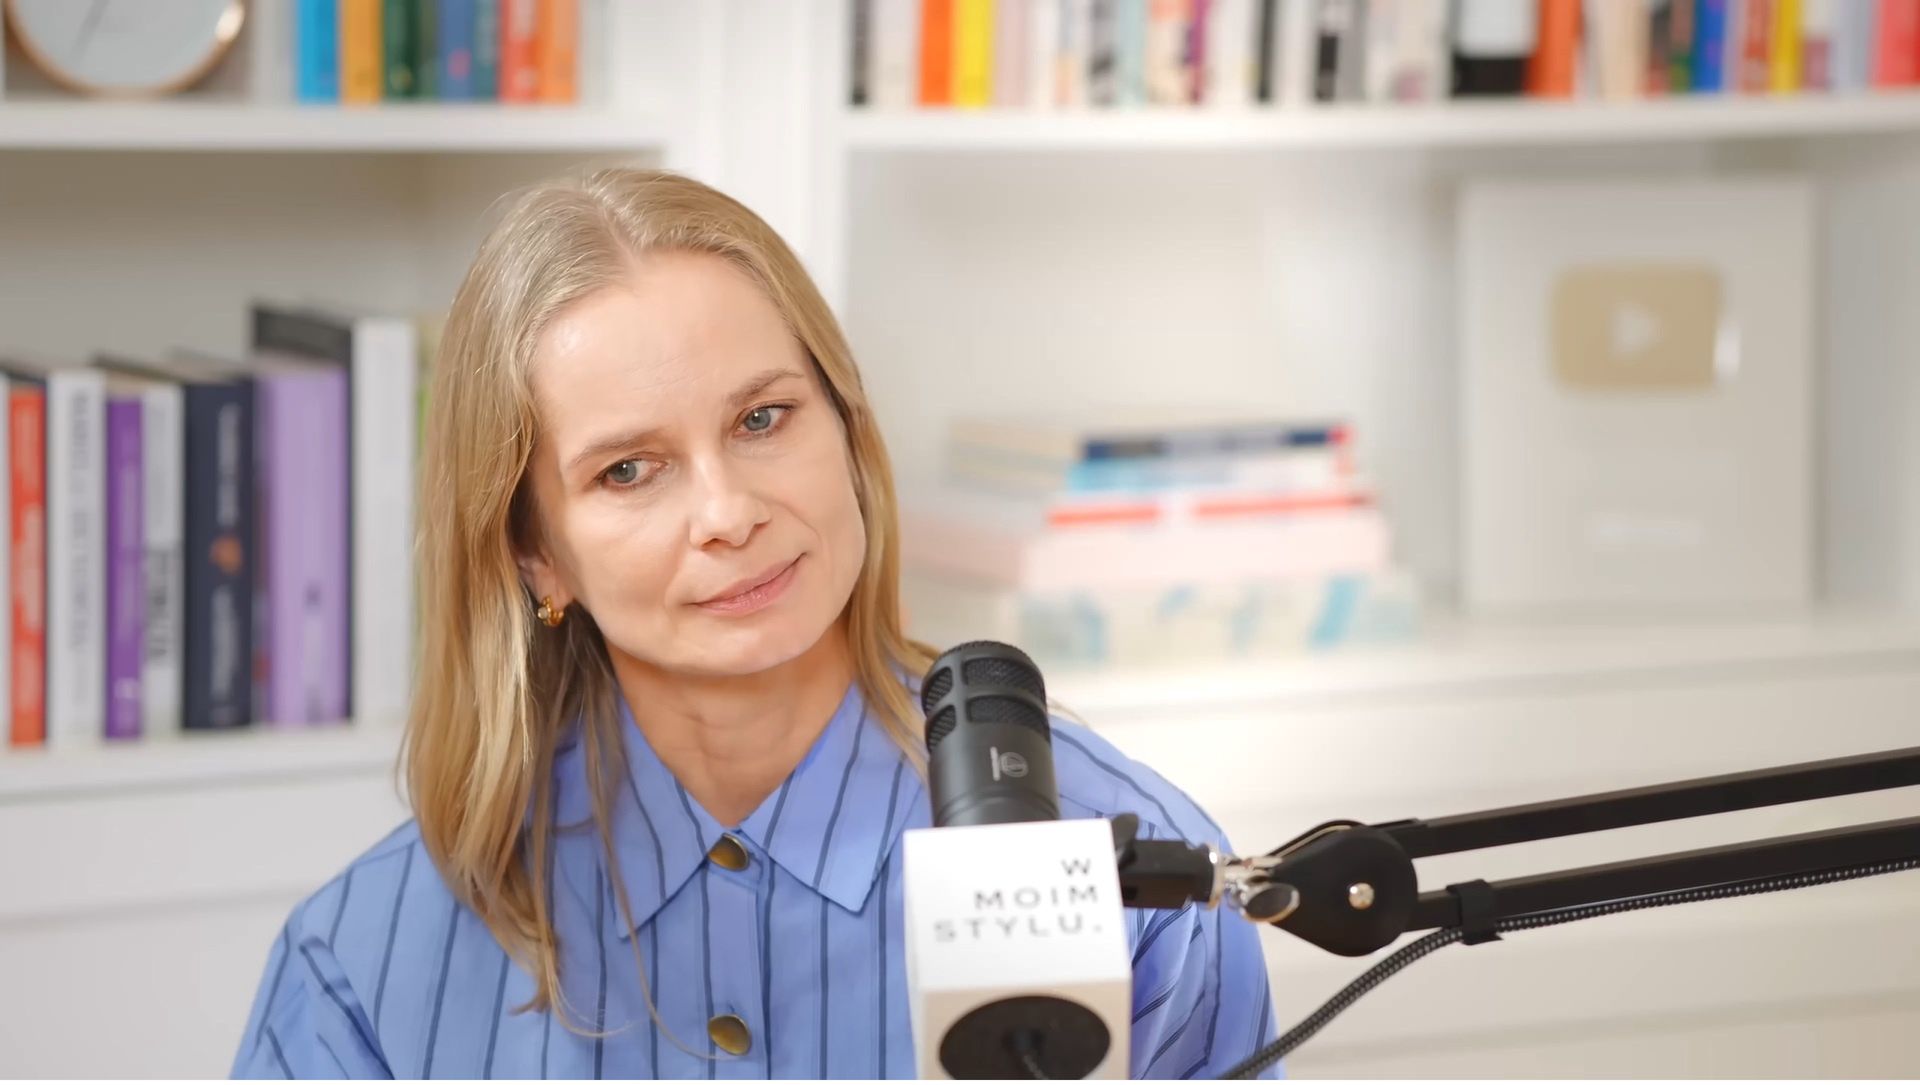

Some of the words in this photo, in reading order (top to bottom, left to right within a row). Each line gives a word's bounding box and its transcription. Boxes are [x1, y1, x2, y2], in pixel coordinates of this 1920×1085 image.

[1061, 857, 1091, 876] W
[973, 884, 1099, 911] MOIM
[933, 913, 1103, 943] STYLU.
